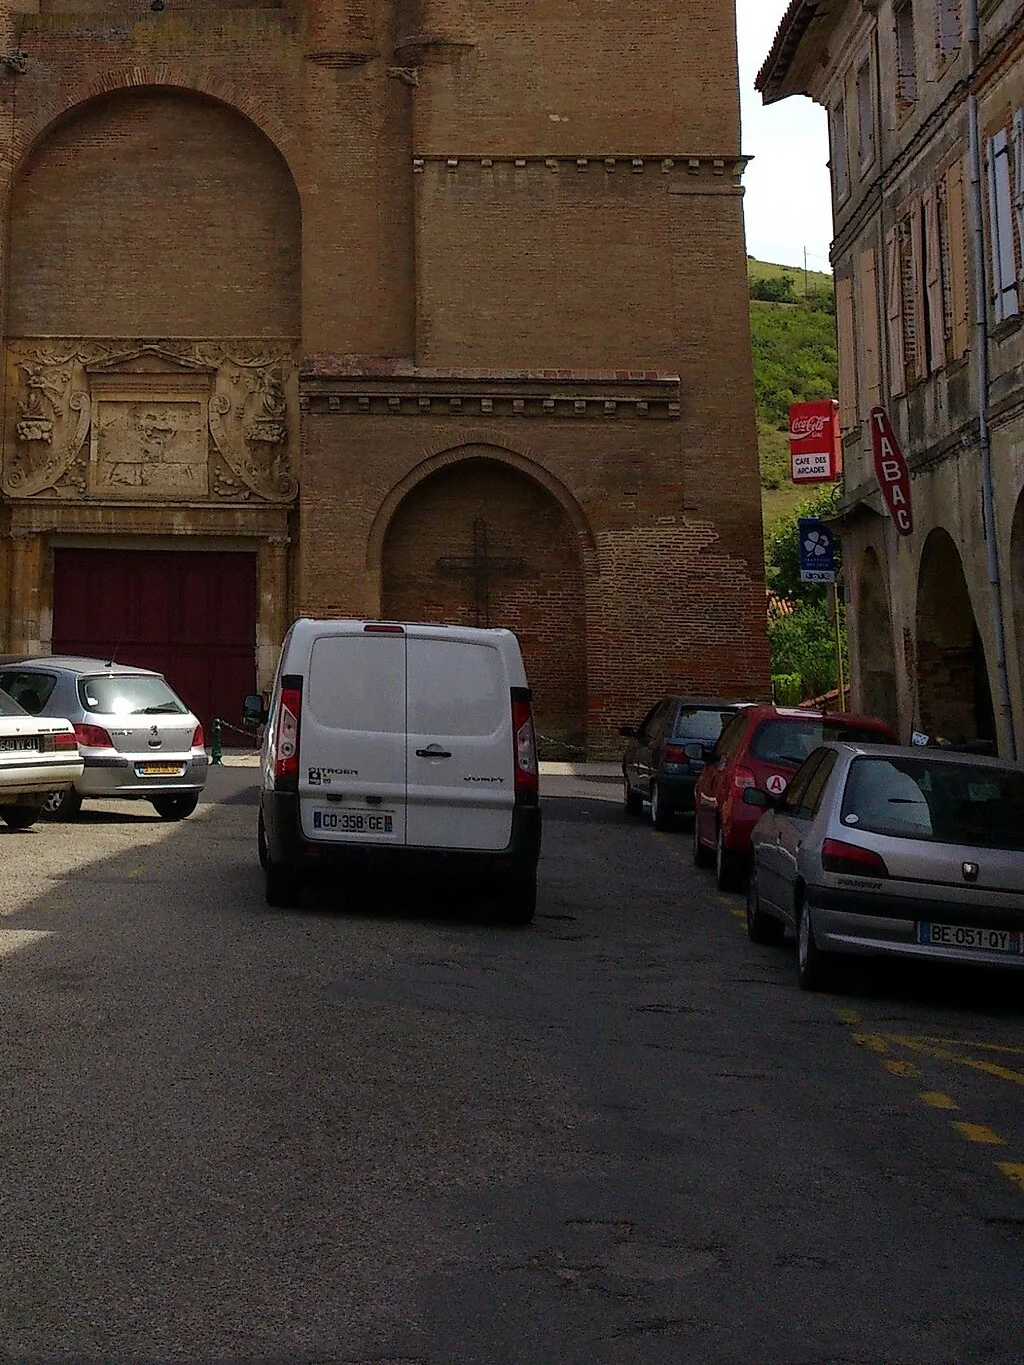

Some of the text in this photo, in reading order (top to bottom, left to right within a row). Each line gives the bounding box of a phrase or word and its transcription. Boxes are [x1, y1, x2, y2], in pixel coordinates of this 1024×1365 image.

[815, 456, 827, 464] DES
[797, 466, 825, 474] ARCADES
[873, 413, 910, 530] TABAC
[463, 774, 505, 783] JUMPY
[770, 776, 782, 791] A
